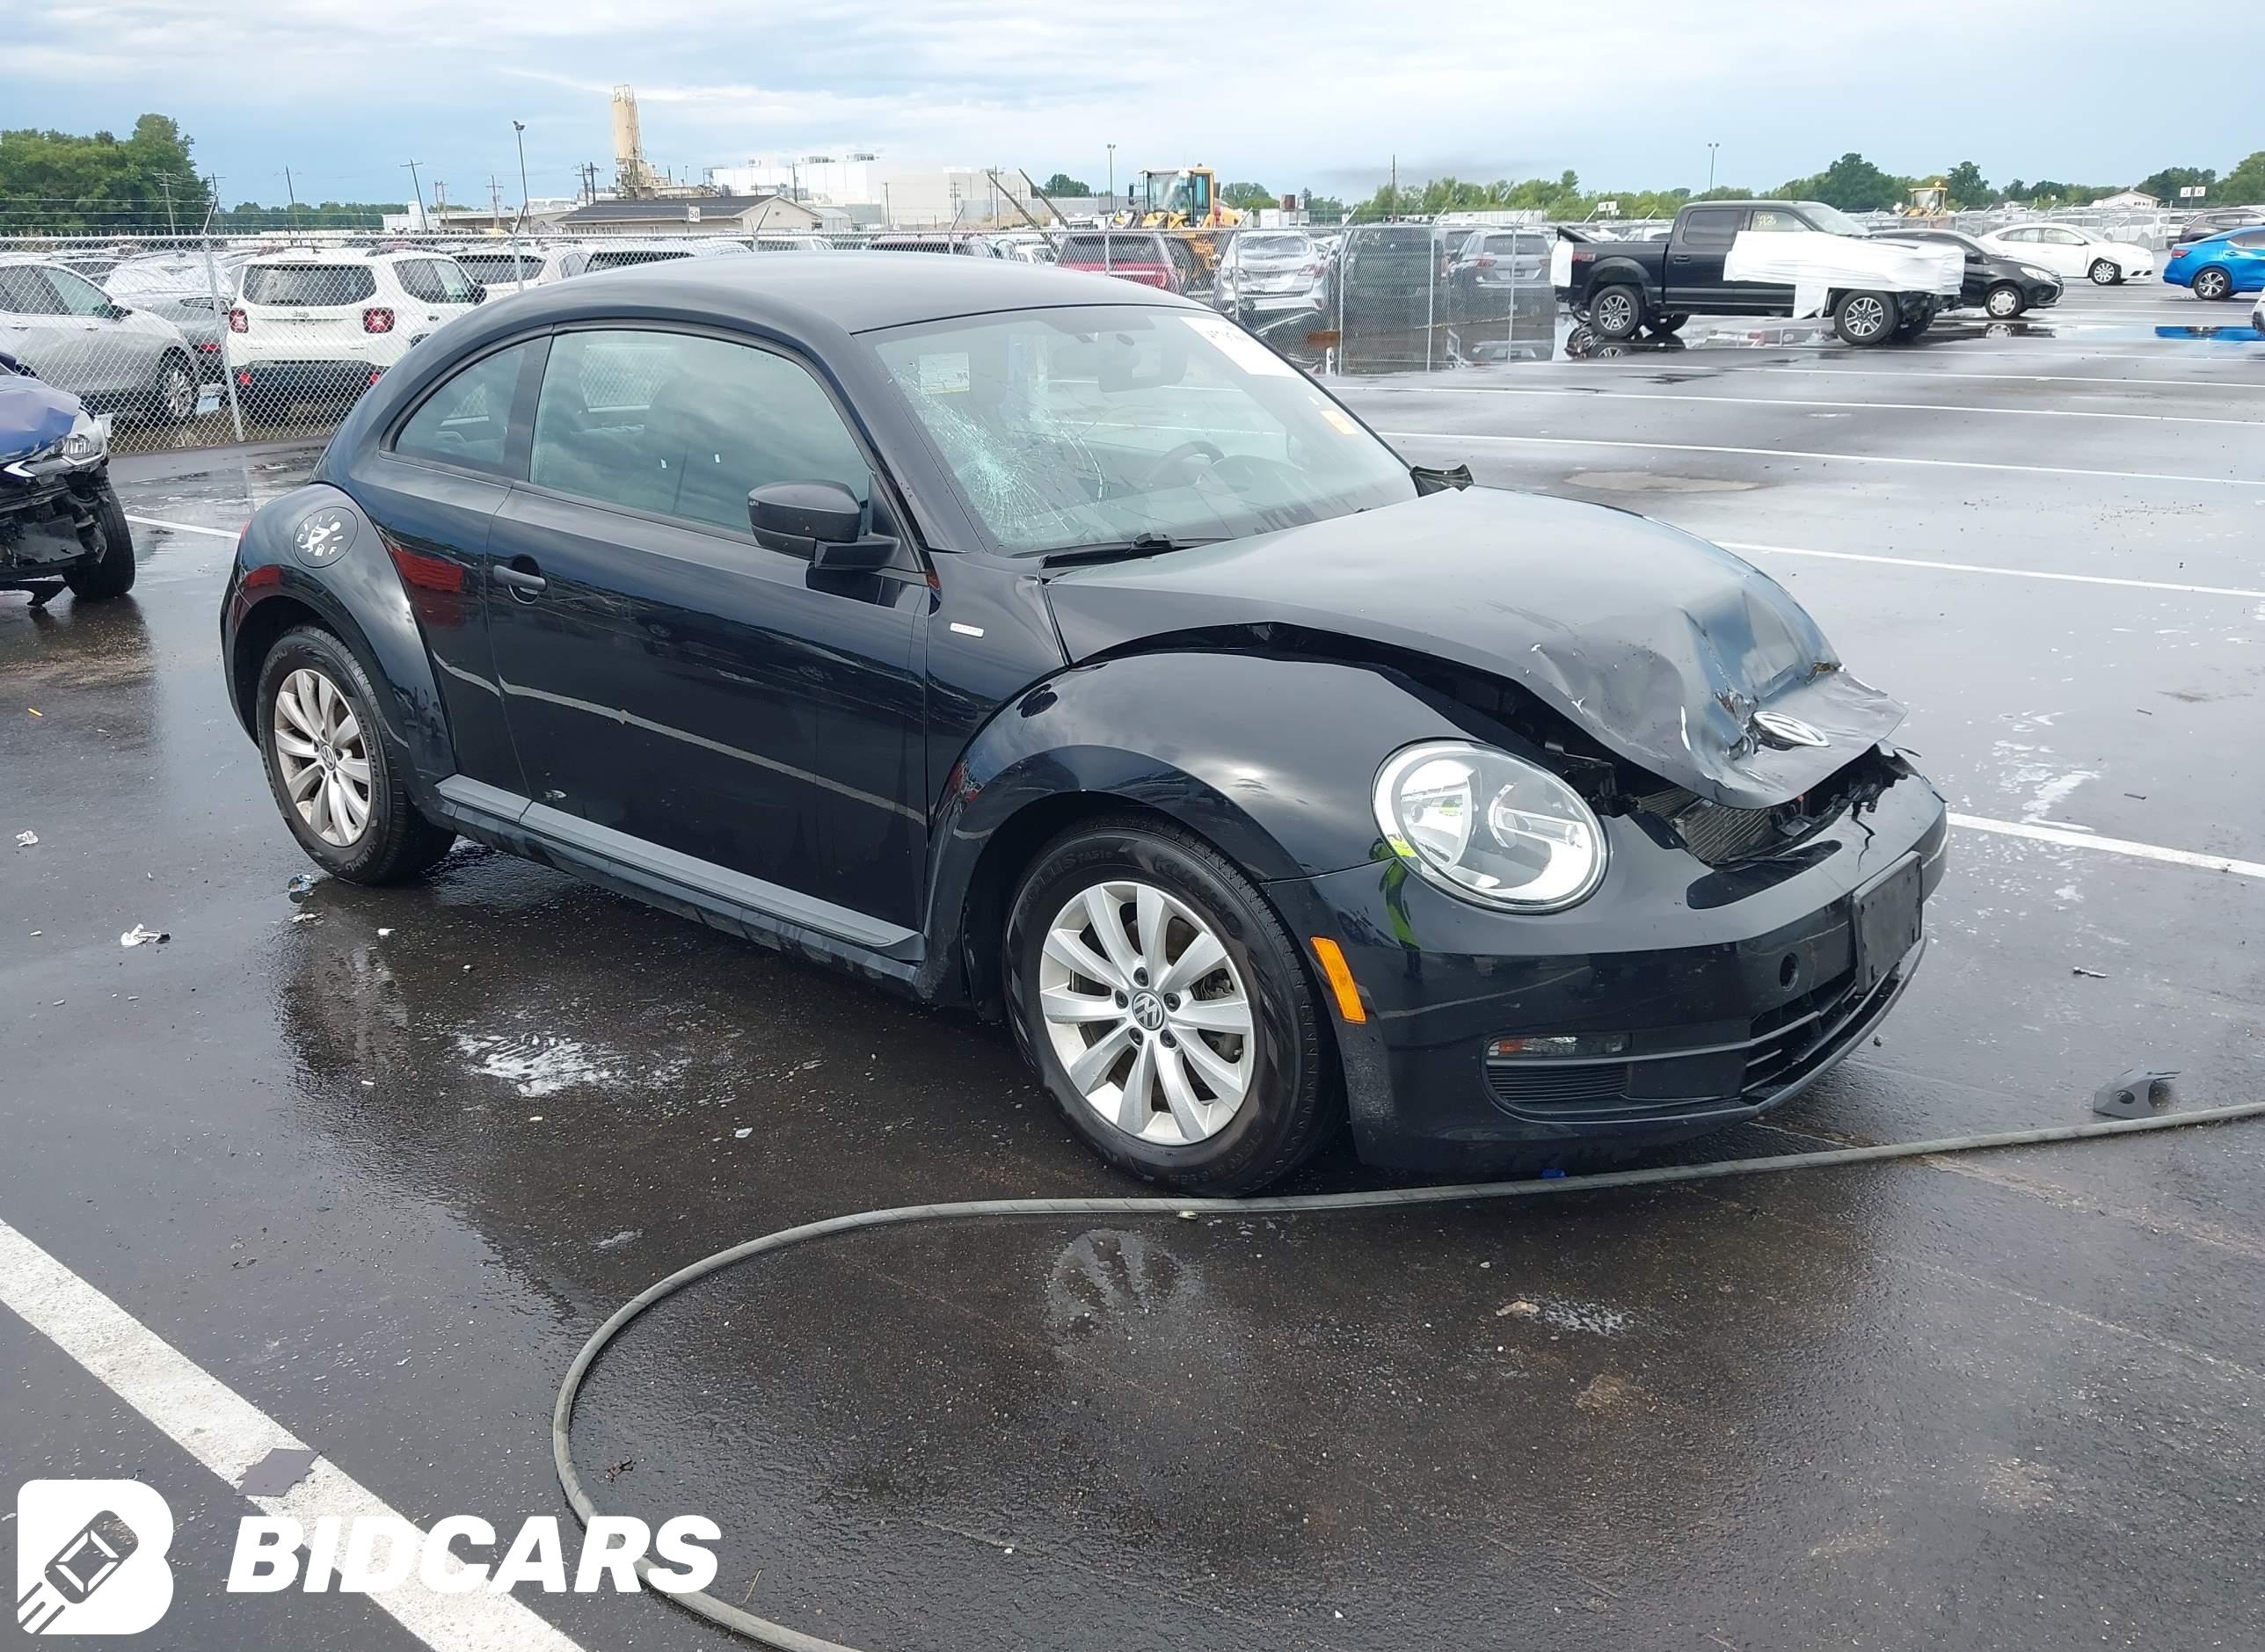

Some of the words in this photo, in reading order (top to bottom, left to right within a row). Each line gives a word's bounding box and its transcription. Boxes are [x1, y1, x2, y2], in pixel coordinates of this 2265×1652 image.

[689, 210, 699, 219] 50
[296, 533, 305, 542] E
[328, 546, 338, 556] F
